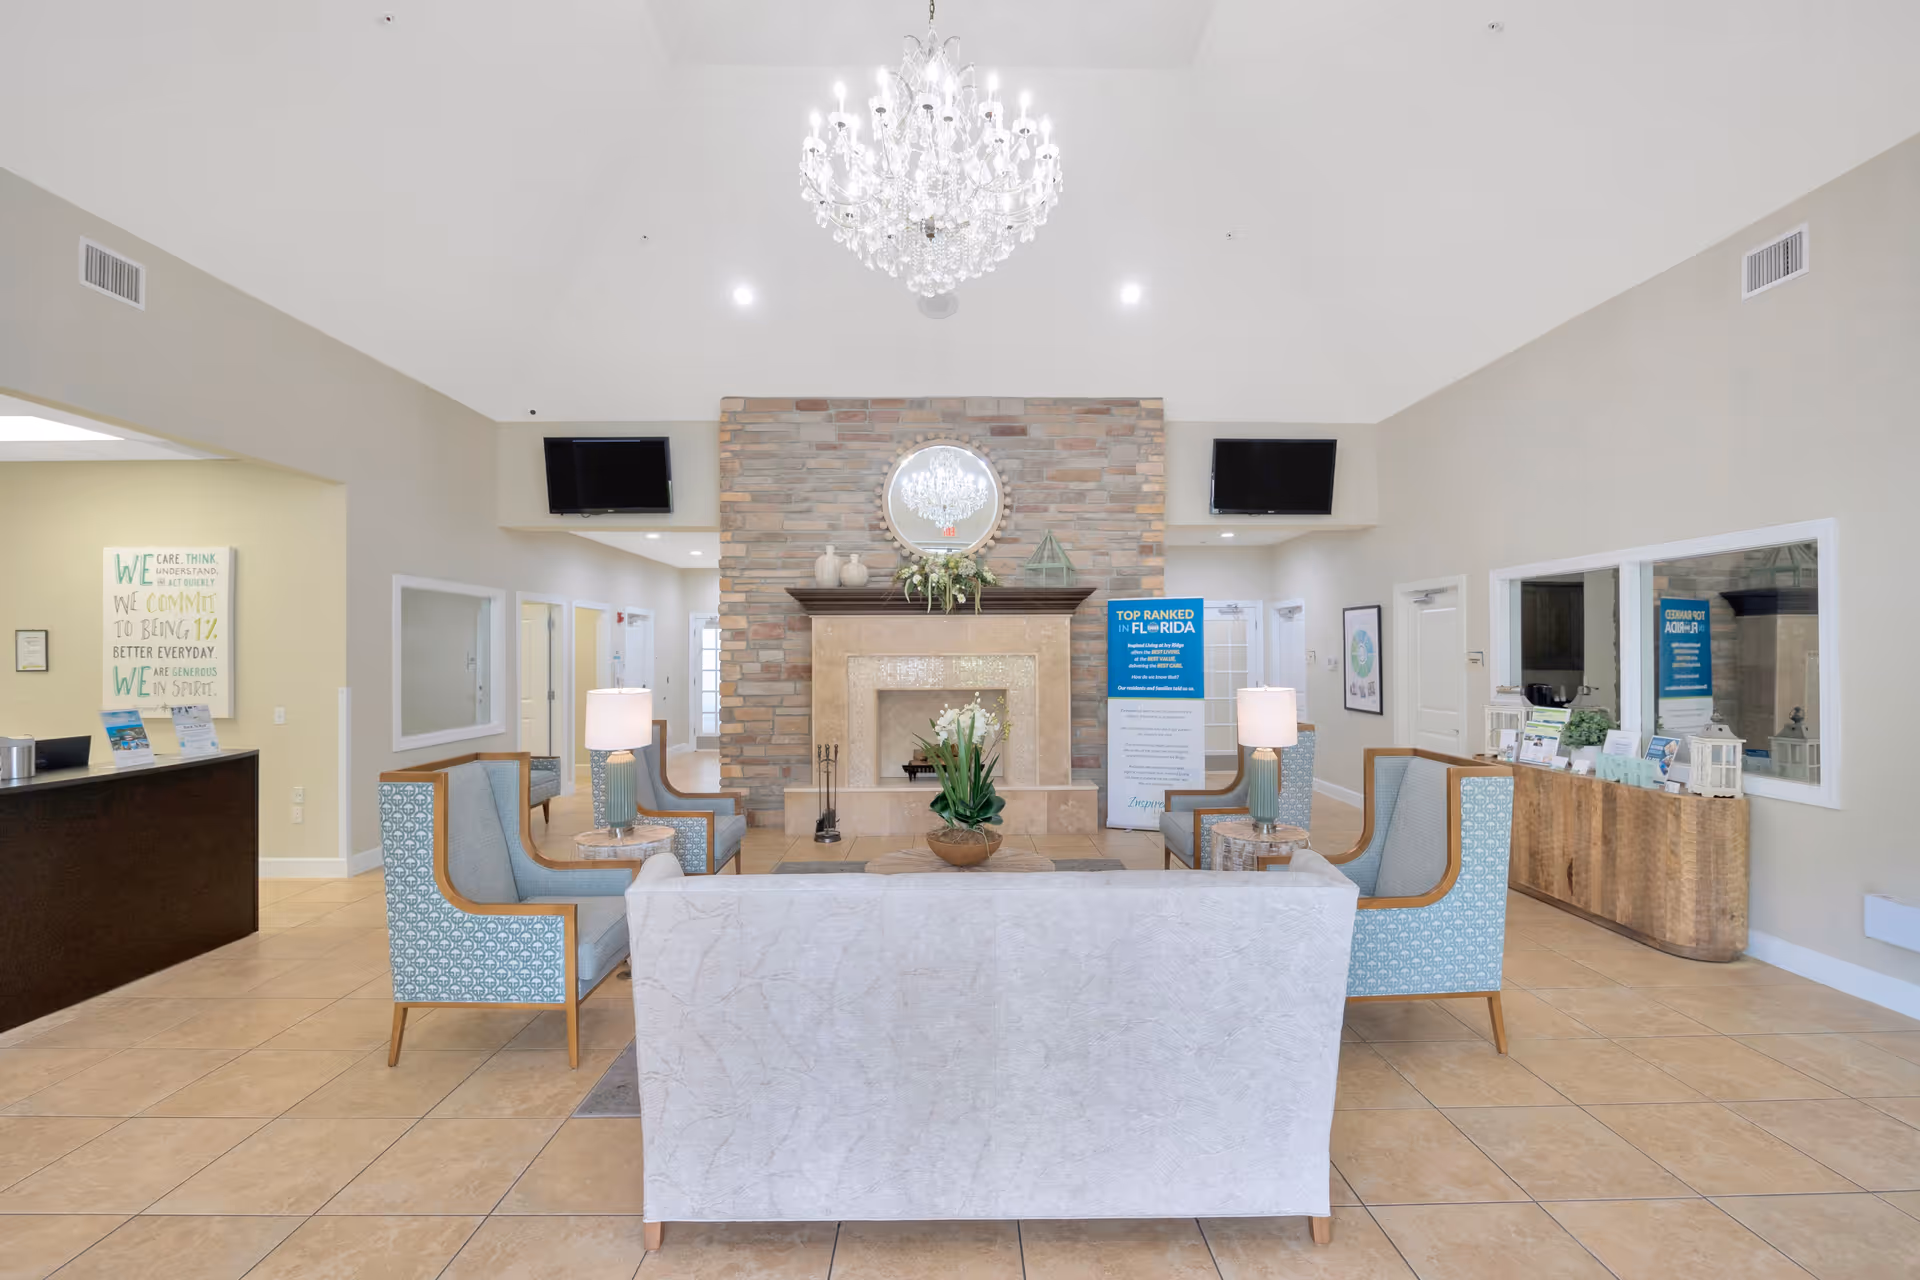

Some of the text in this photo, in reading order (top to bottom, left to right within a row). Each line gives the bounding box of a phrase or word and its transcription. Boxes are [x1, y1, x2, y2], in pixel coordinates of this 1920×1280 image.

[114, 553, 154, 586] WE
[168, 578, 181, 586] ACT
[114, 590, 217, 615] WE COMMIT
[1116, 609, 1195, 621] TOP RANKED
[114, 617, 218, 641] TO BEING 1%
[1118, 624, 1130, 633] IN
[113, 645, 218, 660] BETTER EVERYDAY.
[113, 665, 218, 697] WE ARE GENEROUS
[153, 680, 217, 698] IN SPIRIT.
[1128, 797, 1165, 812] Inspire
